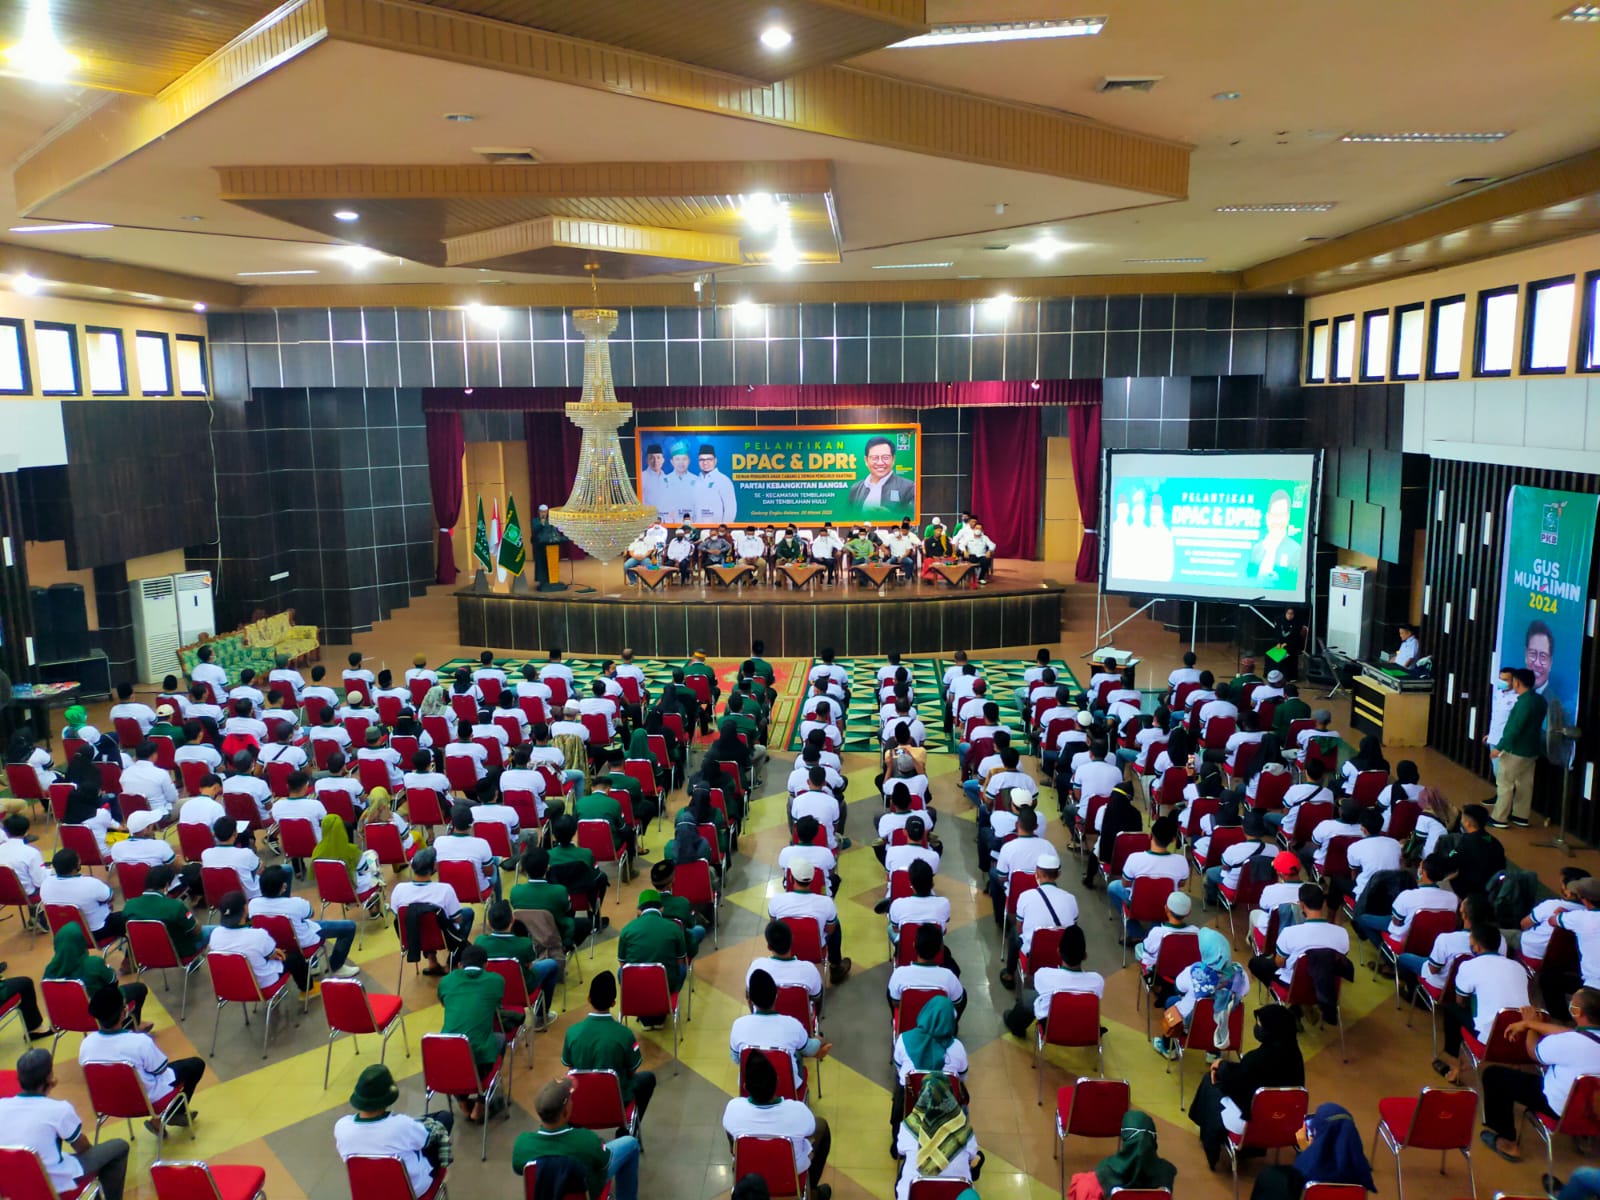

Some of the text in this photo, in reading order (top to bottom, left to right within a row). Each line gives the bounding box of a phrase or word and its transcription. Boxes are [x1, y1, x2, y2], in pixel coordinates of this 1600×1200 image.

[744, 441, 844, 450] PELANTIKAN
[732, 453, 857, 470] DPAC & DPRt
[1181, 492, 1255, 504] PELANTIKAN
[1172, 505, 1211, 525] DPAC
[1211, 506, 1223, 526] &
[1541, 533, 1557, 544] PKB
[1533, 558, 1560, 579] GUS
[1514, 569, 1581, 602] MUHAIMIN
[1529, 592, 1558, 614] 2024
